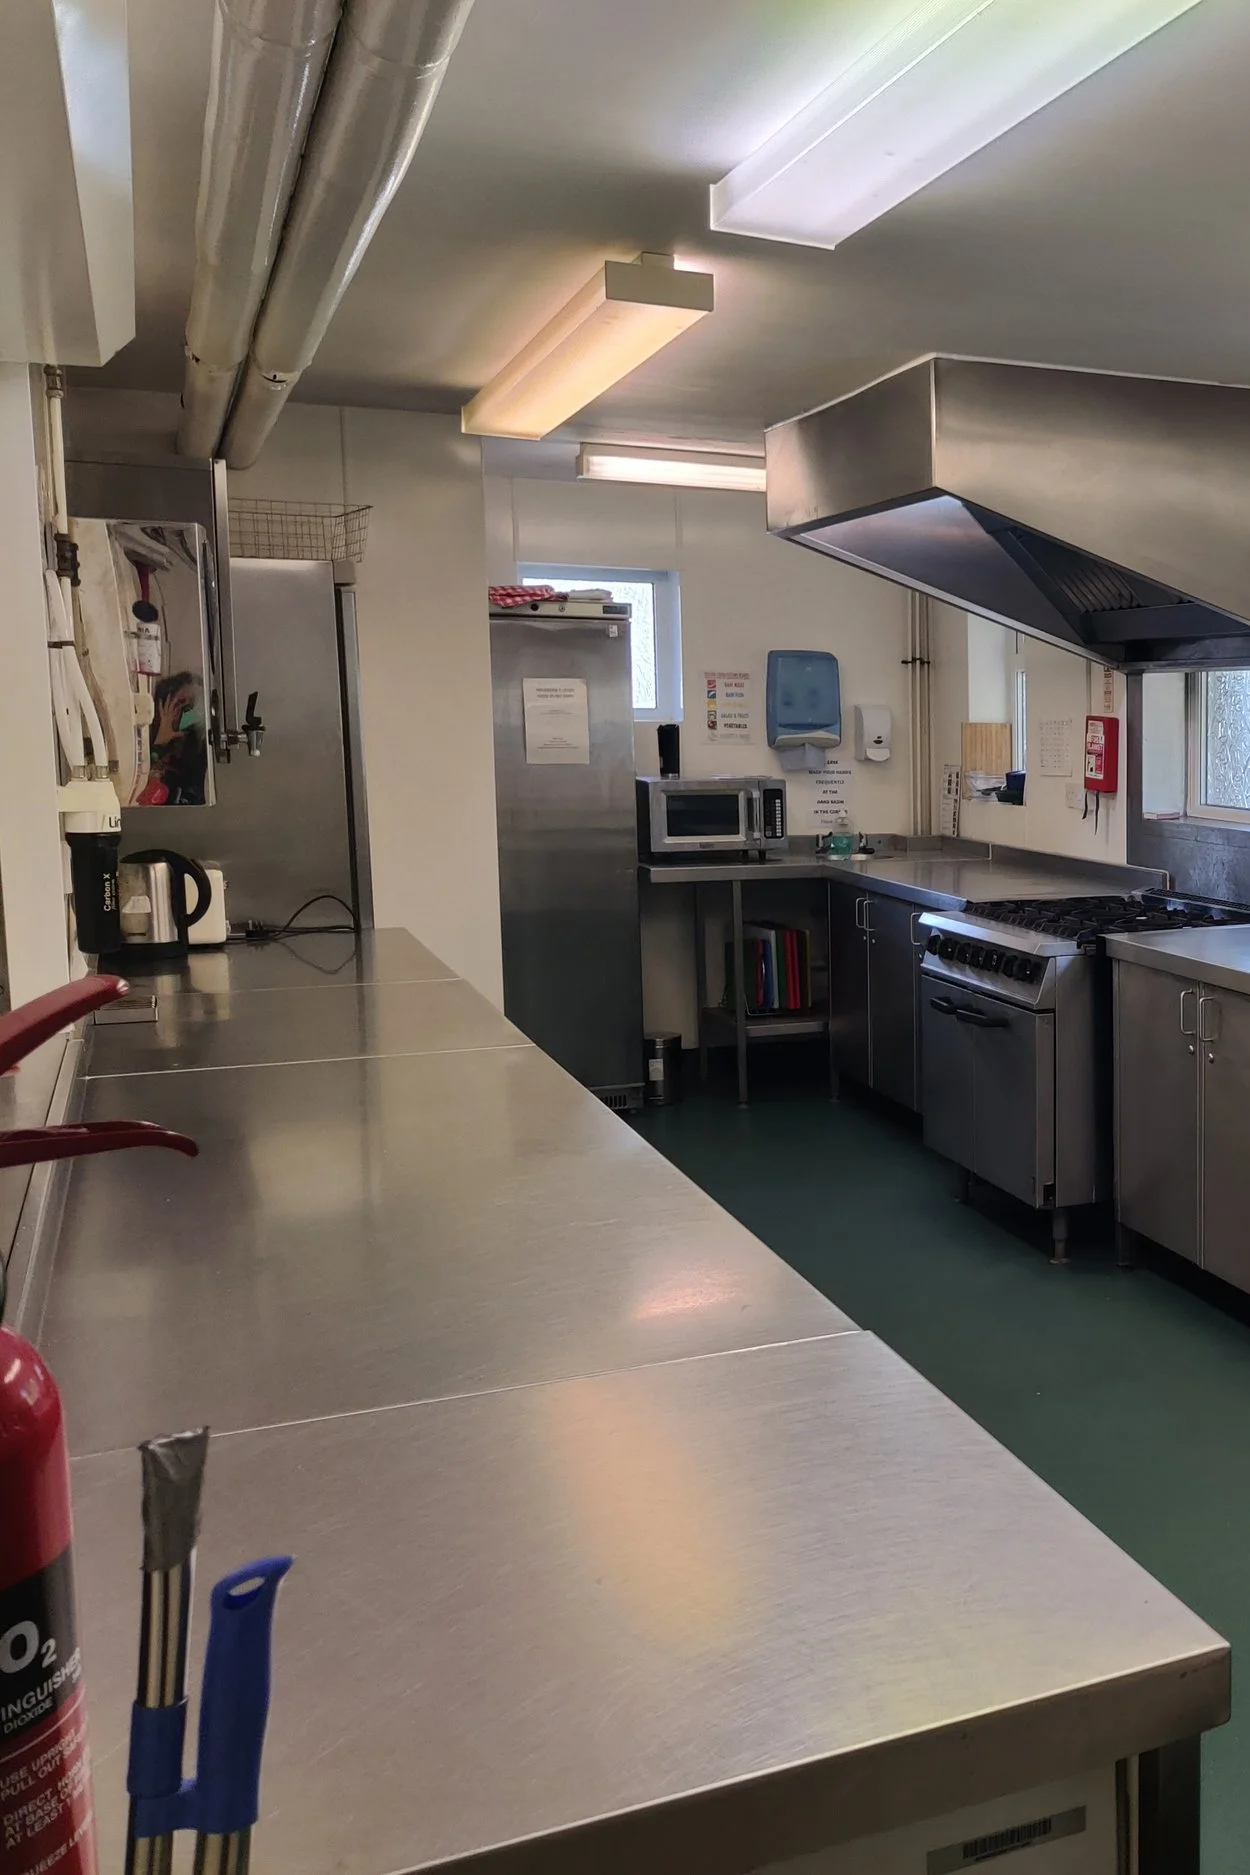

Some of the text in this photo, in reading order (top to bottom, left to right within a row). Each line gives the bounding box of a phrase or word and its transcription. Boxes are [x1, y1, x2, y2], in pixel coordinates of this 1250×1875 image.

[103, 881, 112, 912] Carbon
[3, 1696, 54, 1734] DIOXIDE
[0, 1777, 36, 1802] PULL
[37, 1755, 62, 1779] OUT
[3, 1788, 53, 1827] DIRECT
[6, 1832, 24, 1851] AT
[26, 1802, 65, 1838] LEAST
[25, 1796, 60, 1826] BASE
